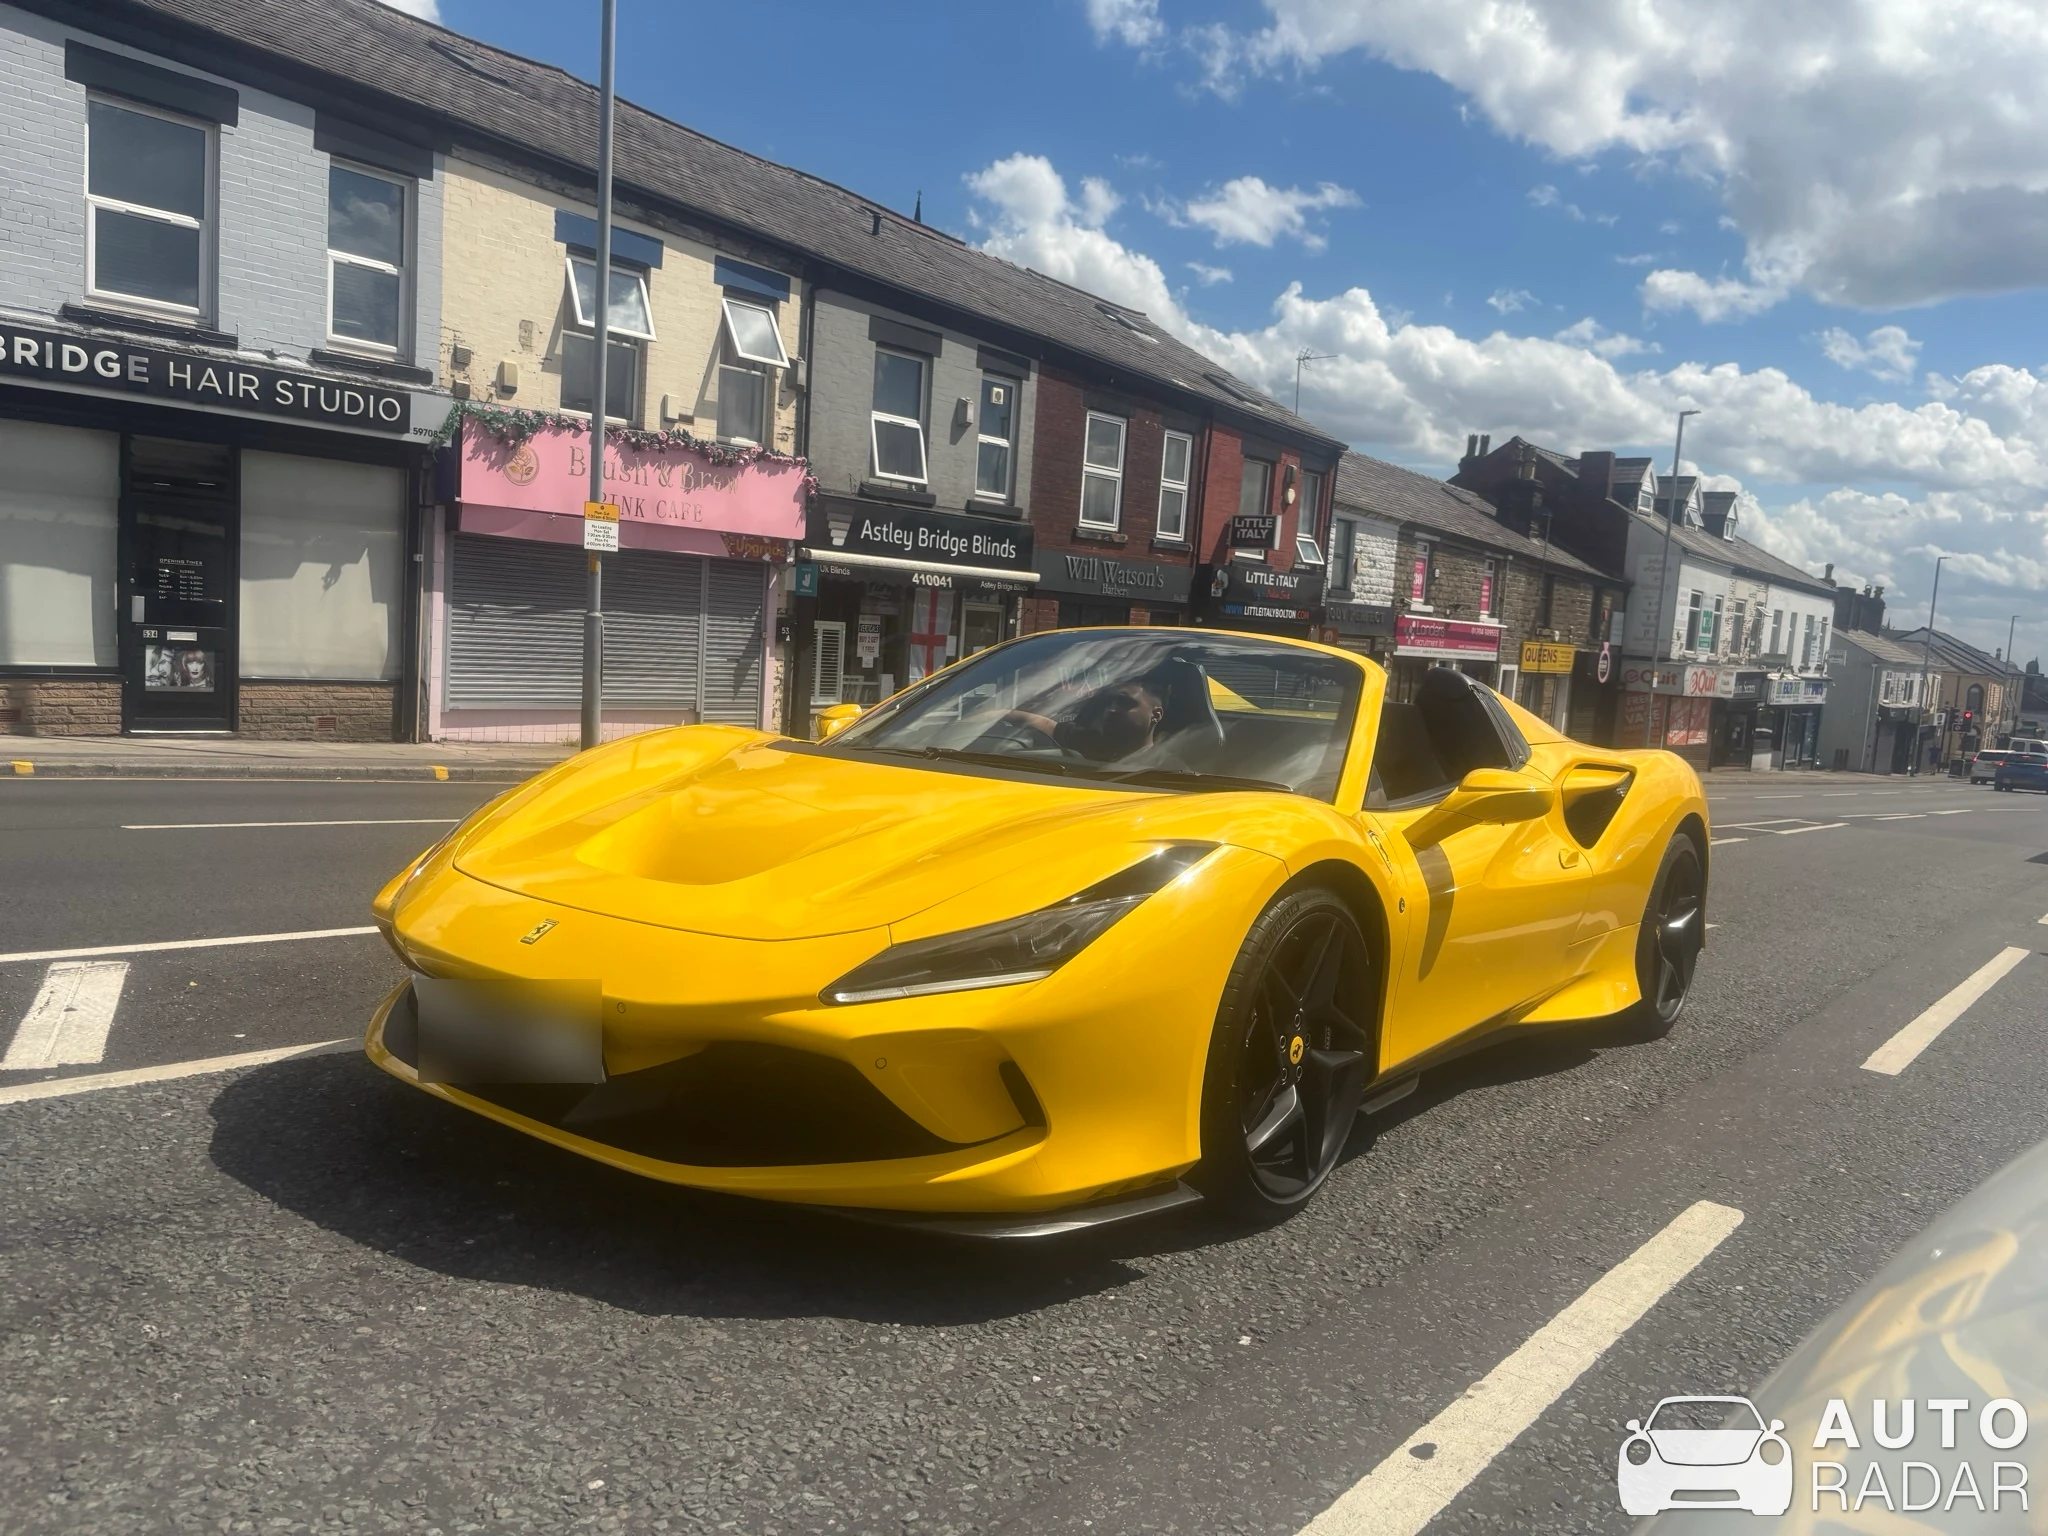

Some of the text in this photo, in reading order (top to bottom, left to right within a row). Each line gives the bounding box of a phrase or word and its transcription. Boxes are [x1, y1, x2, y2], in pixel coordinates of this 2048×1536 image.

[0, 336, 401, 422] RIDGE HAIR STUDIO
[412, 427, 442, 439] 59708
[568, 445, 742, 494] Bush & Brew
[602, 493, 703, 523] INK CAFE
[860, 519, 1017, 559] Astley Bridge Blinds
[911, 572, 953, 588] 410041
[1065, 555, 1165, 588] Will Watson's
[997, 582, 1013, 592] Bridge
[1102, 583, 1129, 596] Barbers
[1525, 648, 1559, 663] QUEENS
